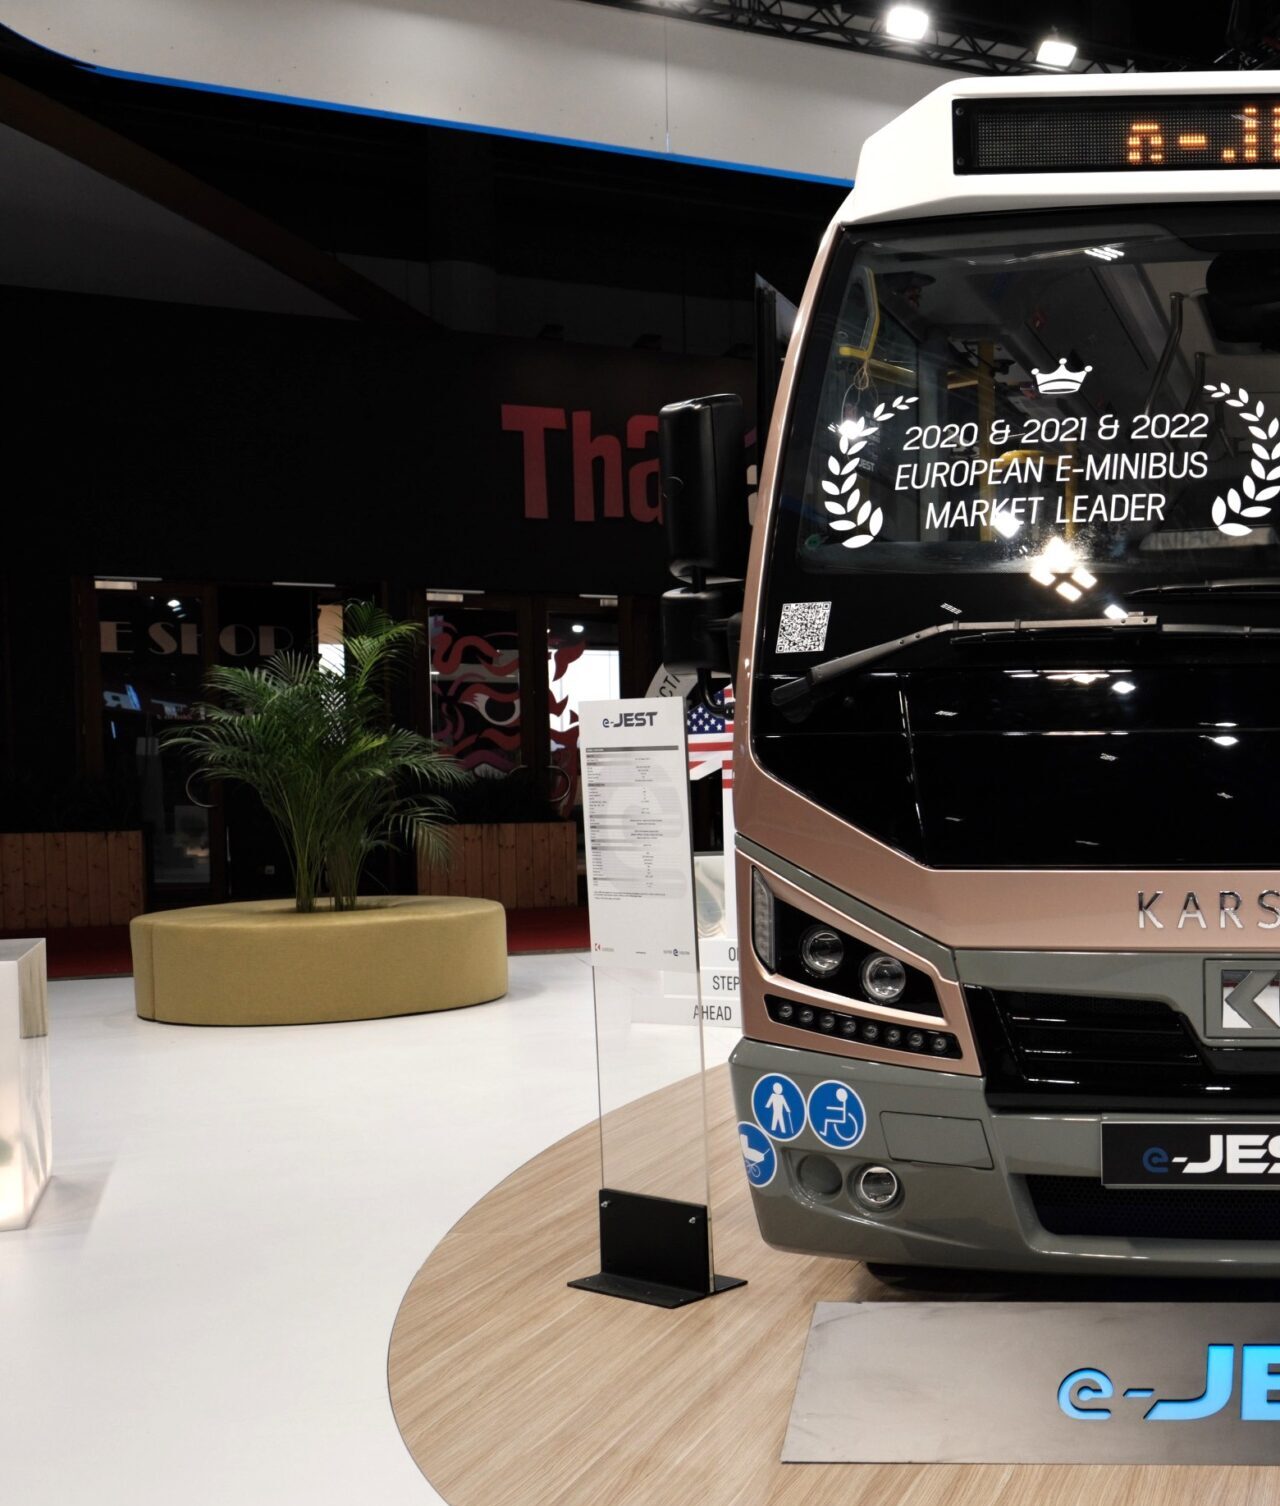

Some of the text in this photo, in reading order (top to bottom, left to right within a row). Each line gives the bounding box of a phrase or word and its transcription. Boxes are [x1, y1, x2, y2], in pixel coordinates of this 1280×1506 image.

[902, 422, 978, 451] 2020
[989, 419, 1010, 444] &
[1020, 416, 1087, 442] 2021
[1098, 414, 1120, 440] &
[1130, 413, 1209, 440] 2022
[894, 451, 1208, 491] EUROPEAN E-MINIBUS
[925, 493, 1165, 530] MARKET LEADER
[602, 711, 658, 728] e-JEST
[712, 975, 740, 991] STEP
[693, 1004, 732, 1020] AHEAD
